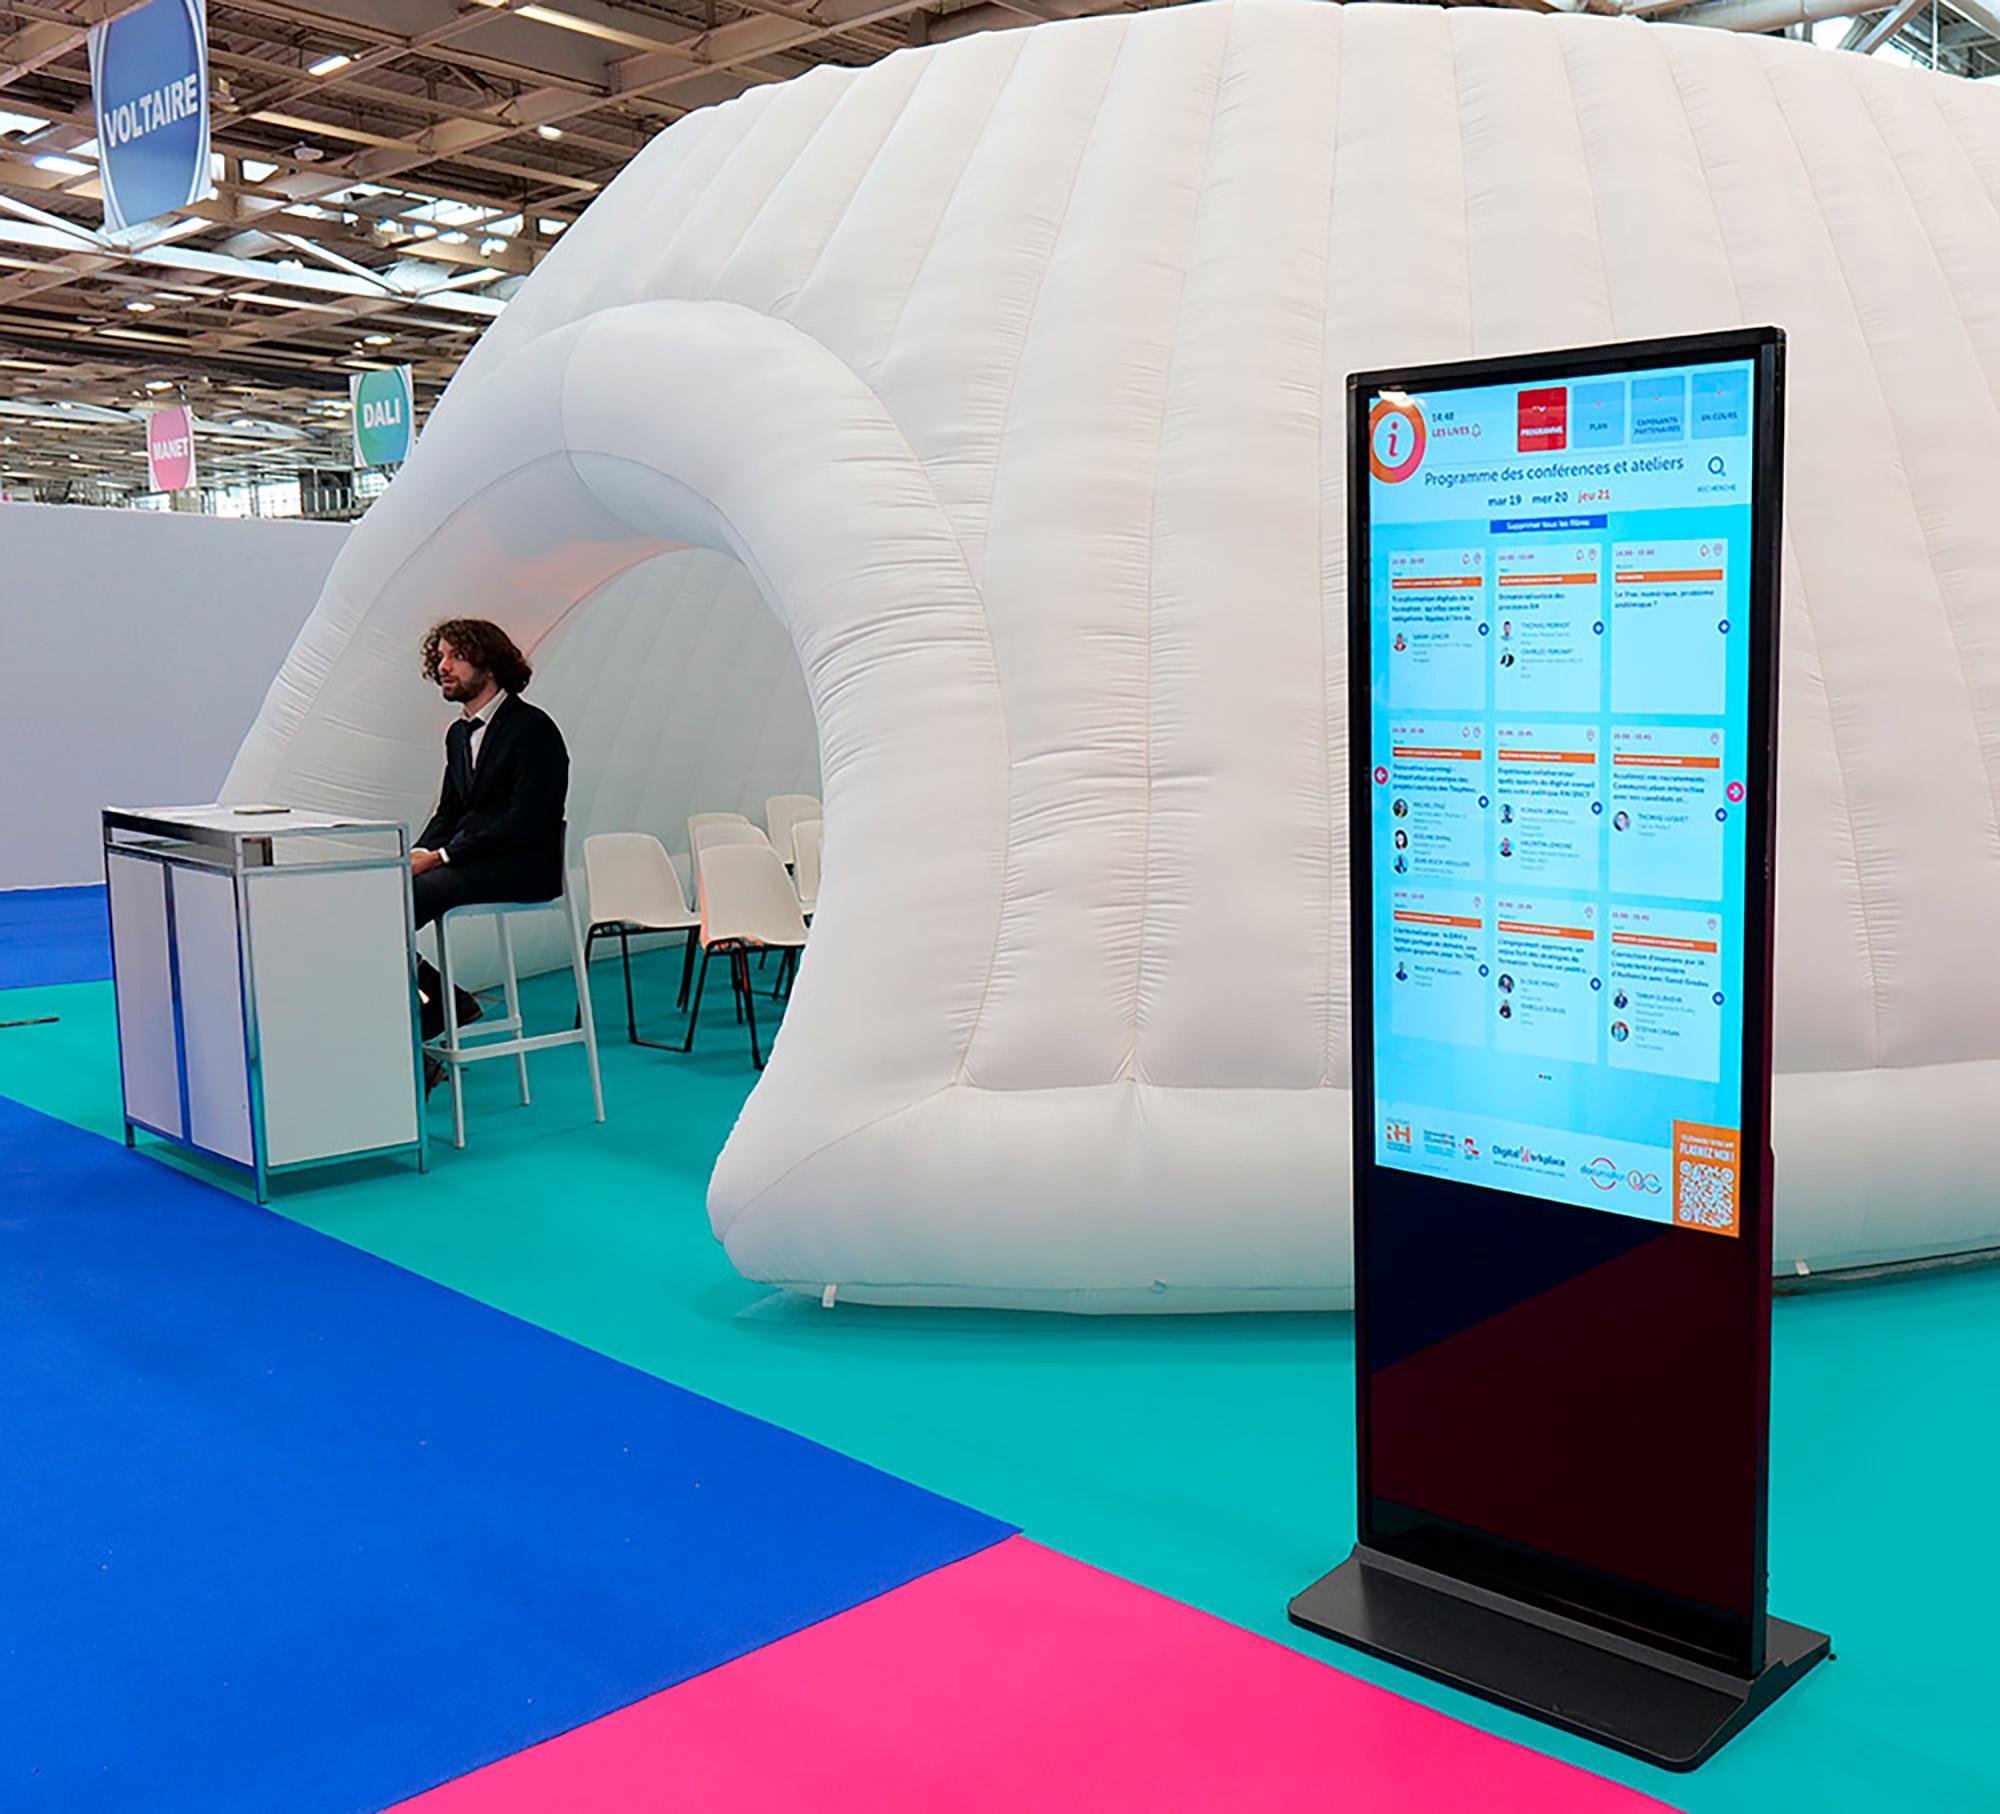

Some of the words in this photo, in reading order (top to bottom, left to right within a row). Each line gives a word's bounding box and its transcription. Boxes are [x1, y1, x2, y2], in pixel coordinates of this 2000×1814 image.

[104, 73, 198, 148] VOLTAIRE
[363, 398, 400, 429] DALI
[1431, 428, 1446, 438] LES
[1447, 426, 1470, 437] LIVES
[1589, 422, 1608, 430] PLAN
[153, 436, 188, 461] MANET
[1425, 470, 1499, 488] Programme
[1501, 466, 1524, 481] des
[1527, 463, 1610, 479] conférences
[1613, 460, 1628, 474] et
[1631, 456, 1684, 472] ateliers
[1488, 497, 1507, 506] mar
[1509, 494, 1523, 506] 19
[1532, 495, 1552, 505] mer
[1555, 492, 1568, 503] 20
[1578, 489, 1595, 503] jeu
[1598, 489, 1611, 500] 21
[1386, 1122, 1411, 1144] RH
